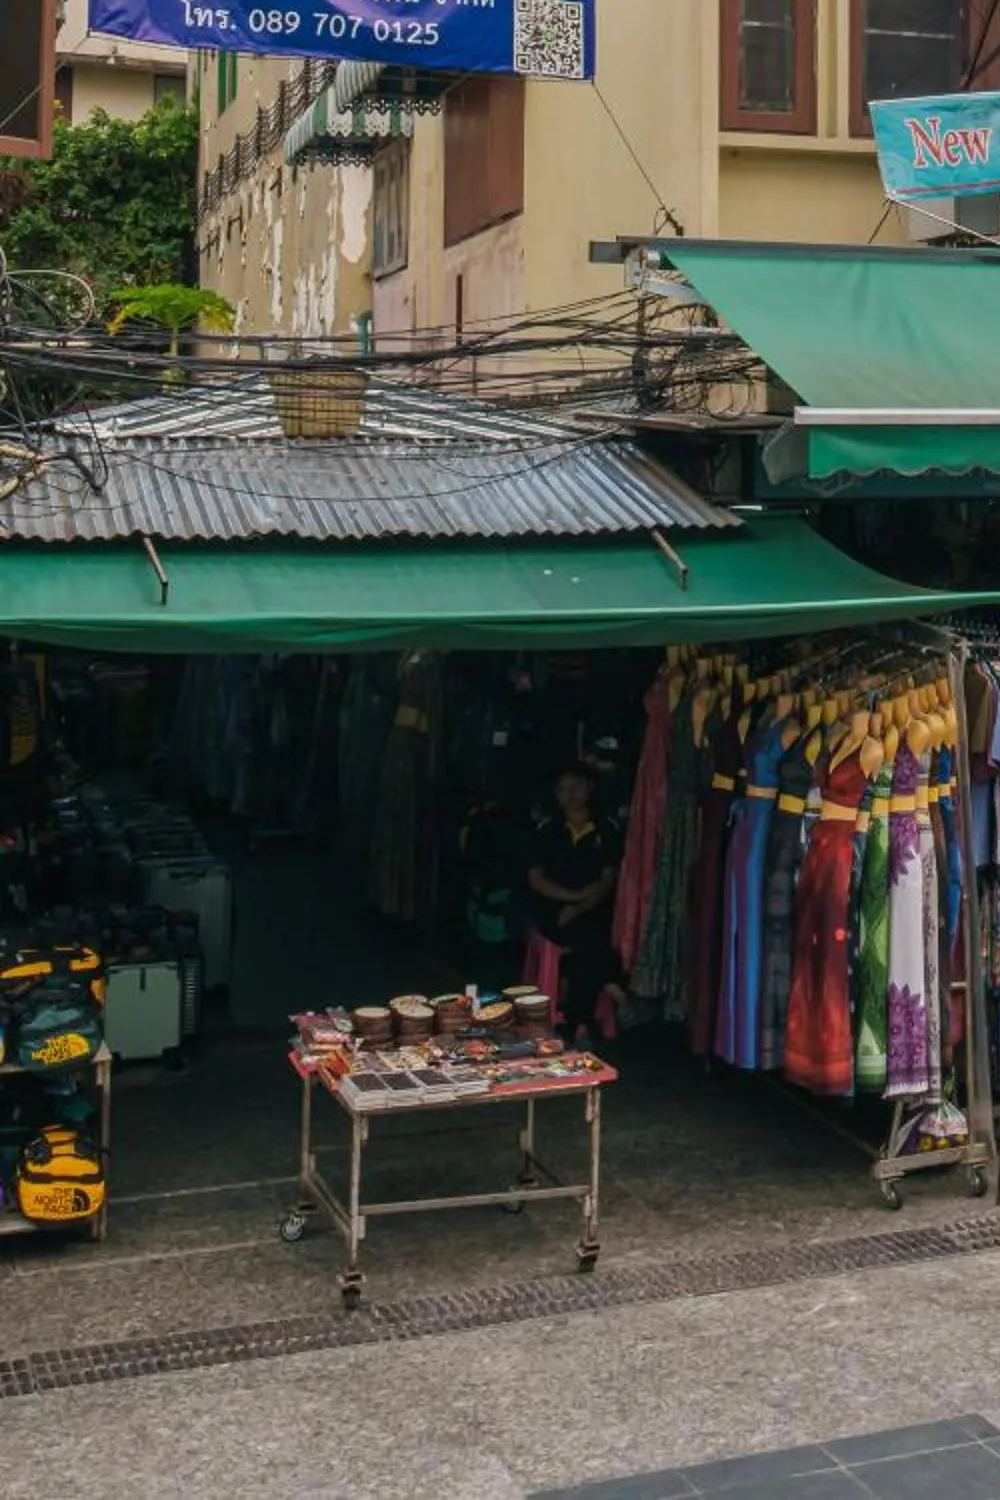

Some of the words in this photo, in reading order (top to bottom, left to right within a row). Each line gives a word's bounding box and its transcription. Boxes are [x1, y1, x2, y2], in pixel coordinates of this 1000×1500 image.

[249, 9, 300, 34] 089
[313, 13, 363, 39] 707
[373, 19, 440, 45] 0125
[904, 116, 993, 169] New
